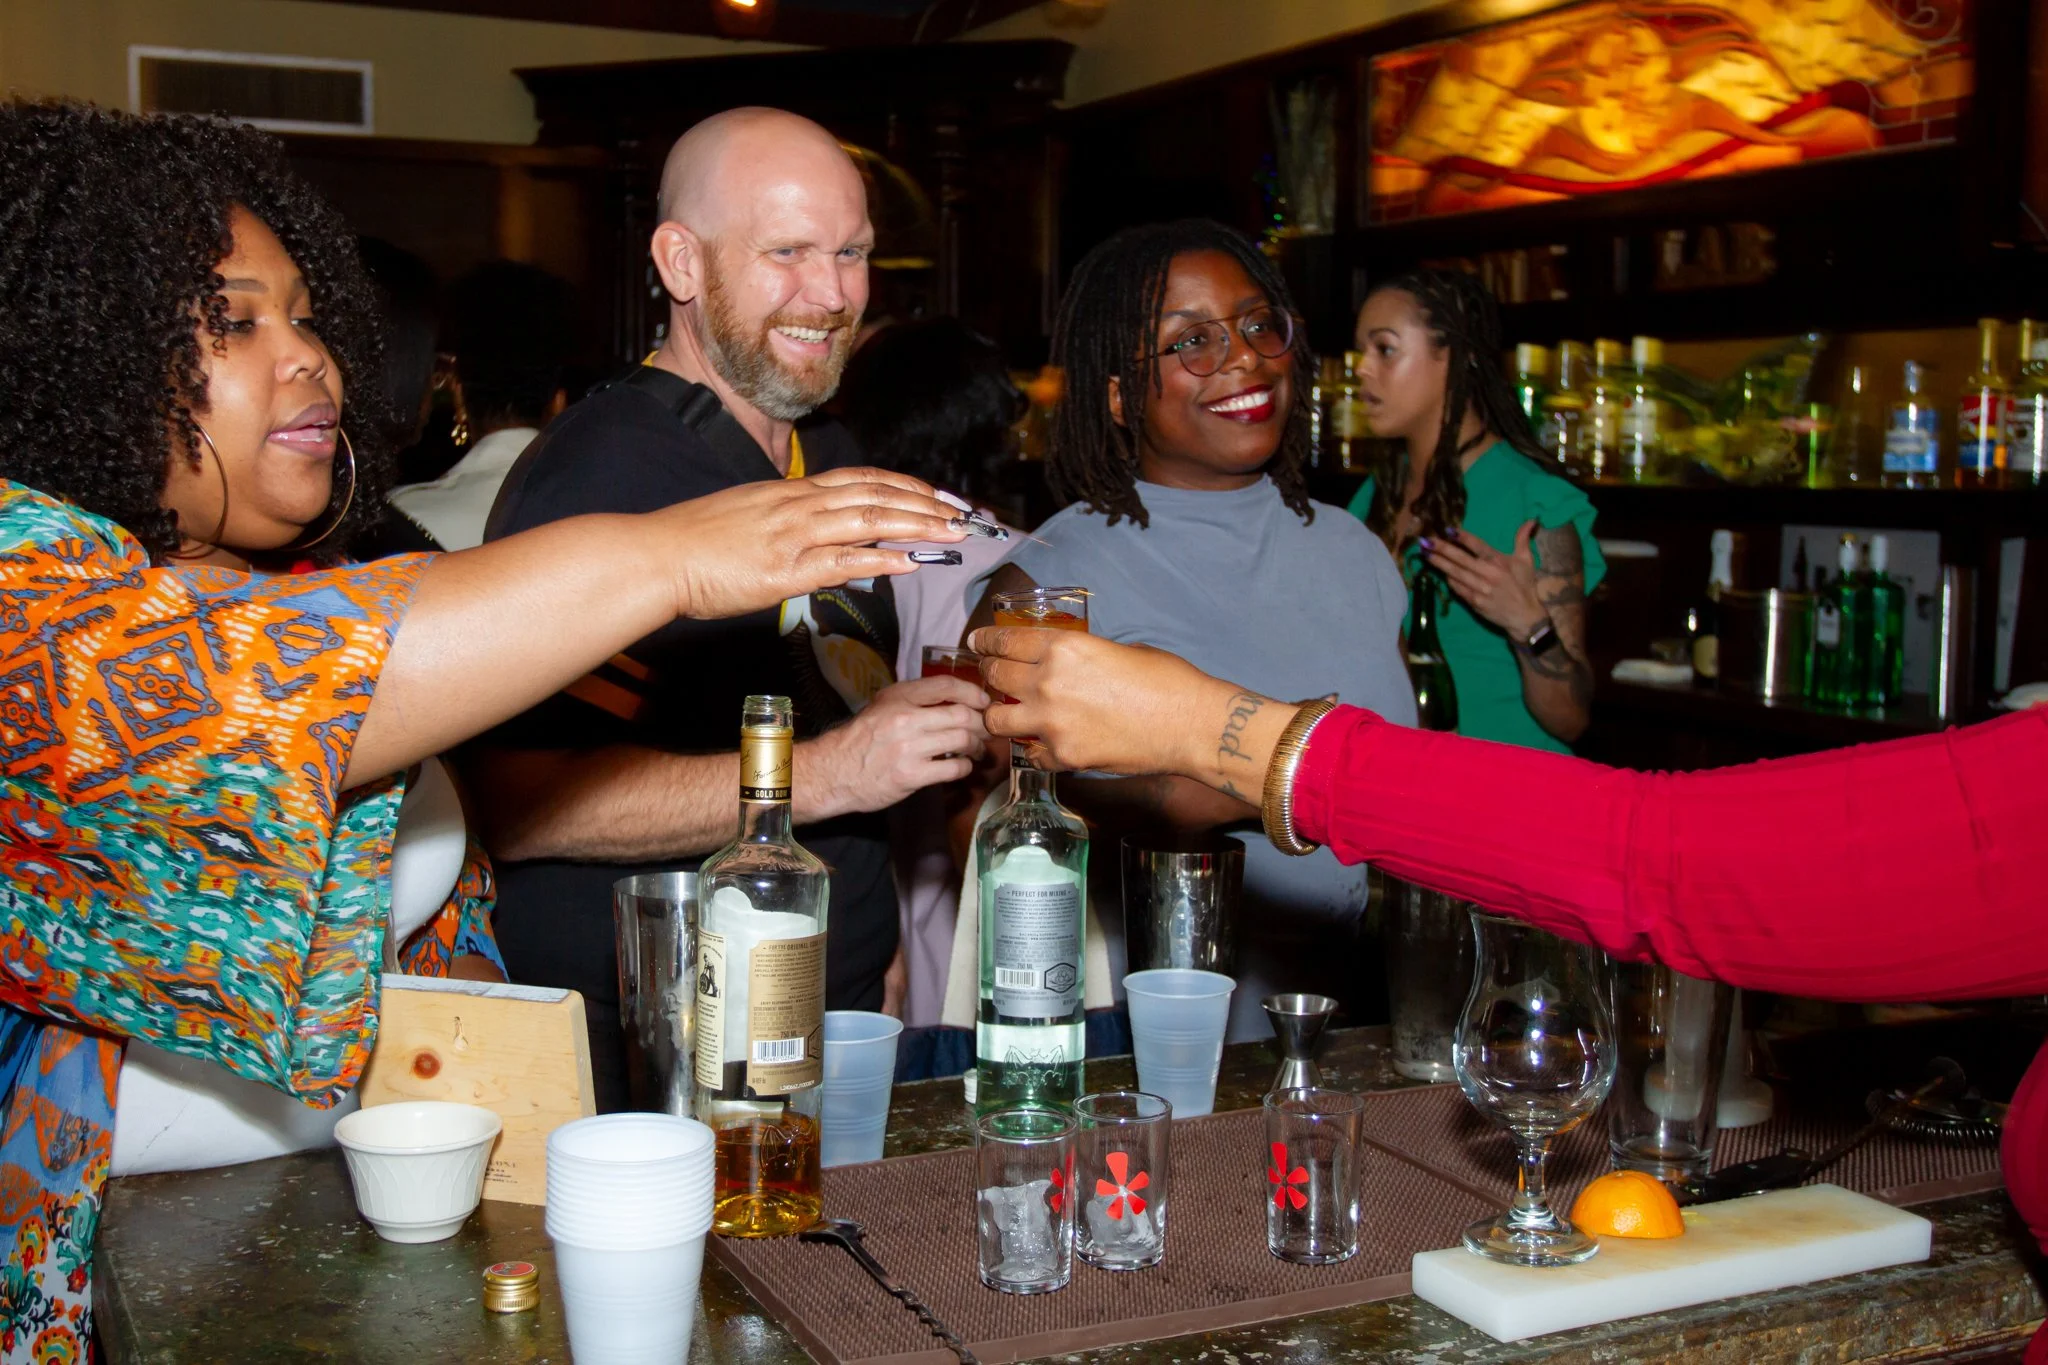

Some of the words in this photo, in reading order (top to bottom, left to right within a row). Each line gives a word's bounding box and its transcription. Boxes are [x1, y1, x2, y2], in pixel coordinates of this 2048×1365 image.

[755, 789, 774, 799] GOLD
[1011, 890, 1036, 898] PERFECT
[1037, 890, 1048, 898] FOR
[1048, 889, 1067, 897] MIXING
[786, 942, 808, 951] ORIGINAL
